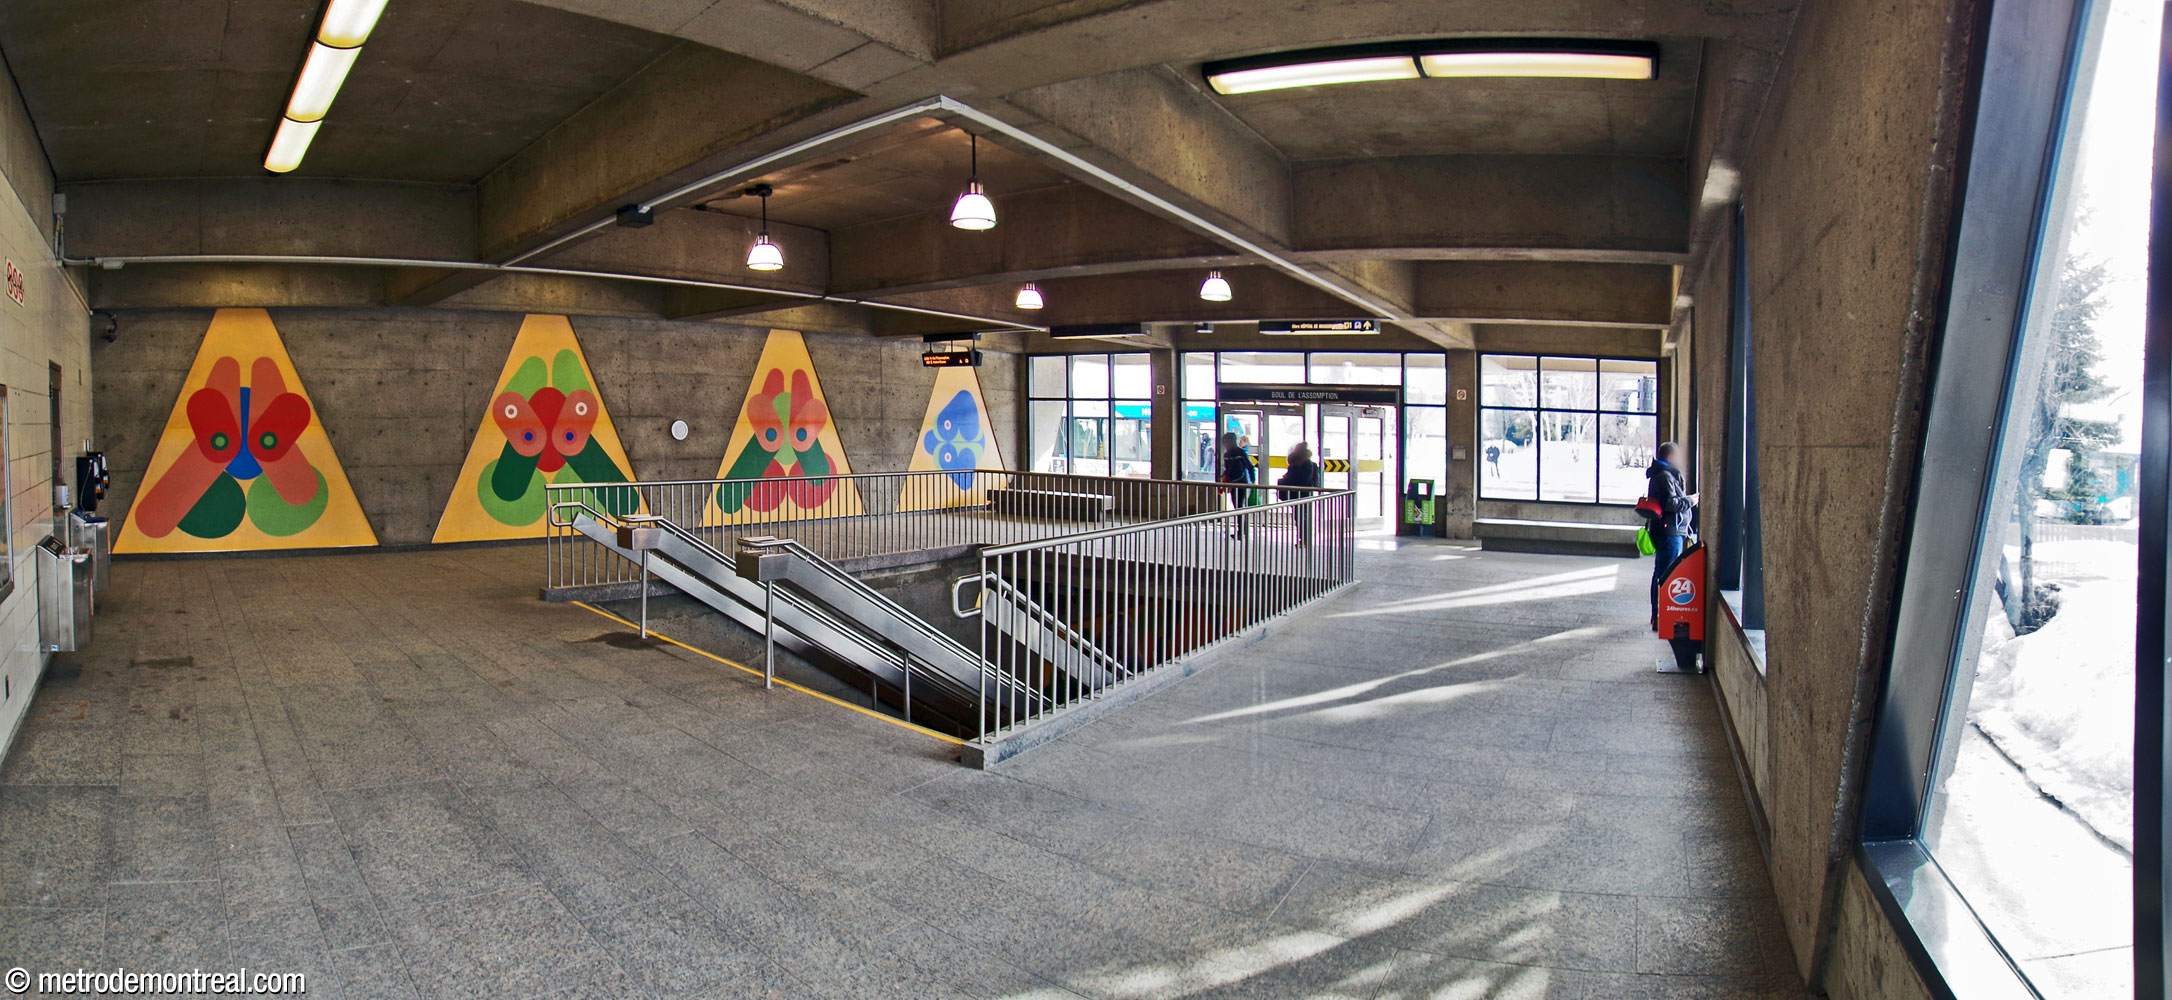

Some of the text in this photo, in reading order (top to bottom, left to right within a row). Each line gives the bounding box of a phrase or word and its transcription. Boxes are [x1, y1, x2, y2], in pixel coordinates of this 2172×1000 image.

[1271, 391, 1339, 400] BOUL DE L'ASSOMPTION
[1672, 579, 1692, 594] 24
